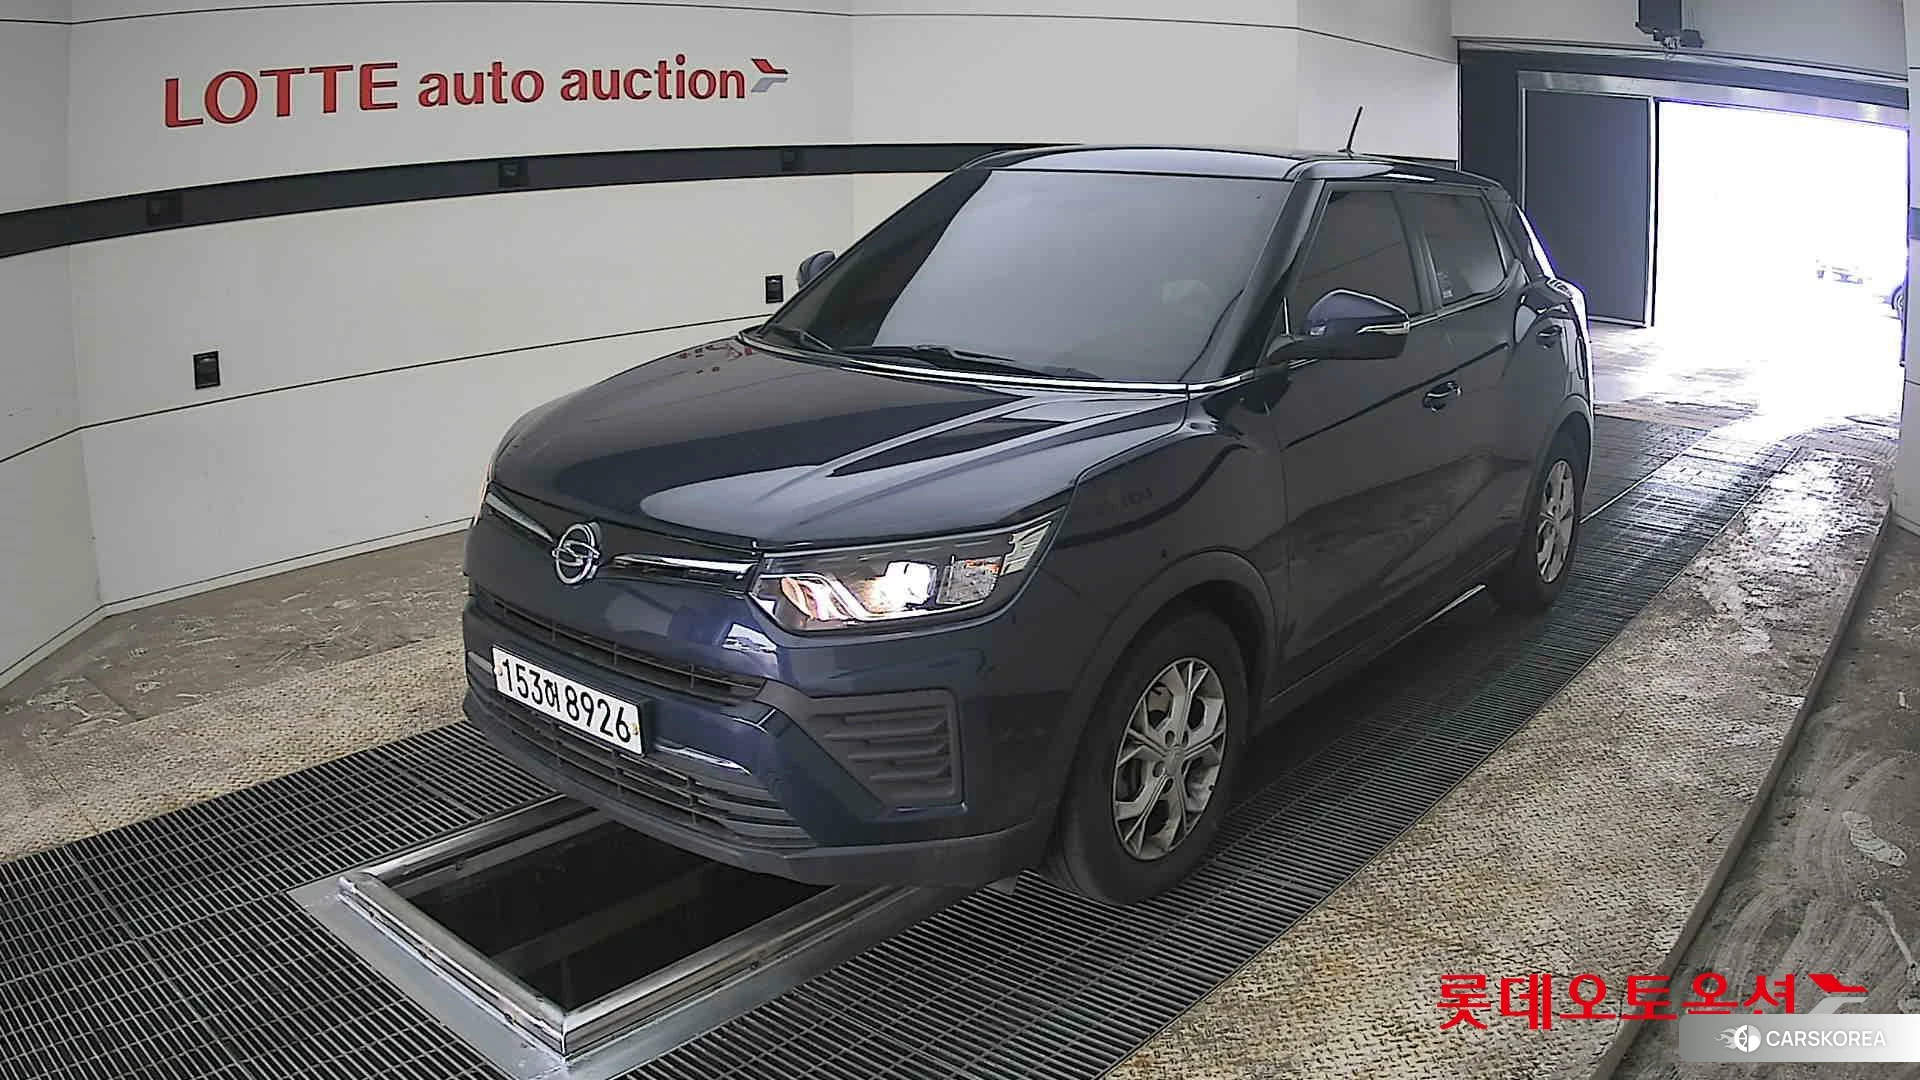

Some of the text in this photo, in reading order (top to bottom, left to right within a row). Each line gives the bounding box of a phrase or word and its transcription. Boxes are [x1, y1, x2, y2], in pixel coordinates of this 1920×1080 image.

[165, 54, 747, 128] LOTTE auto auction
